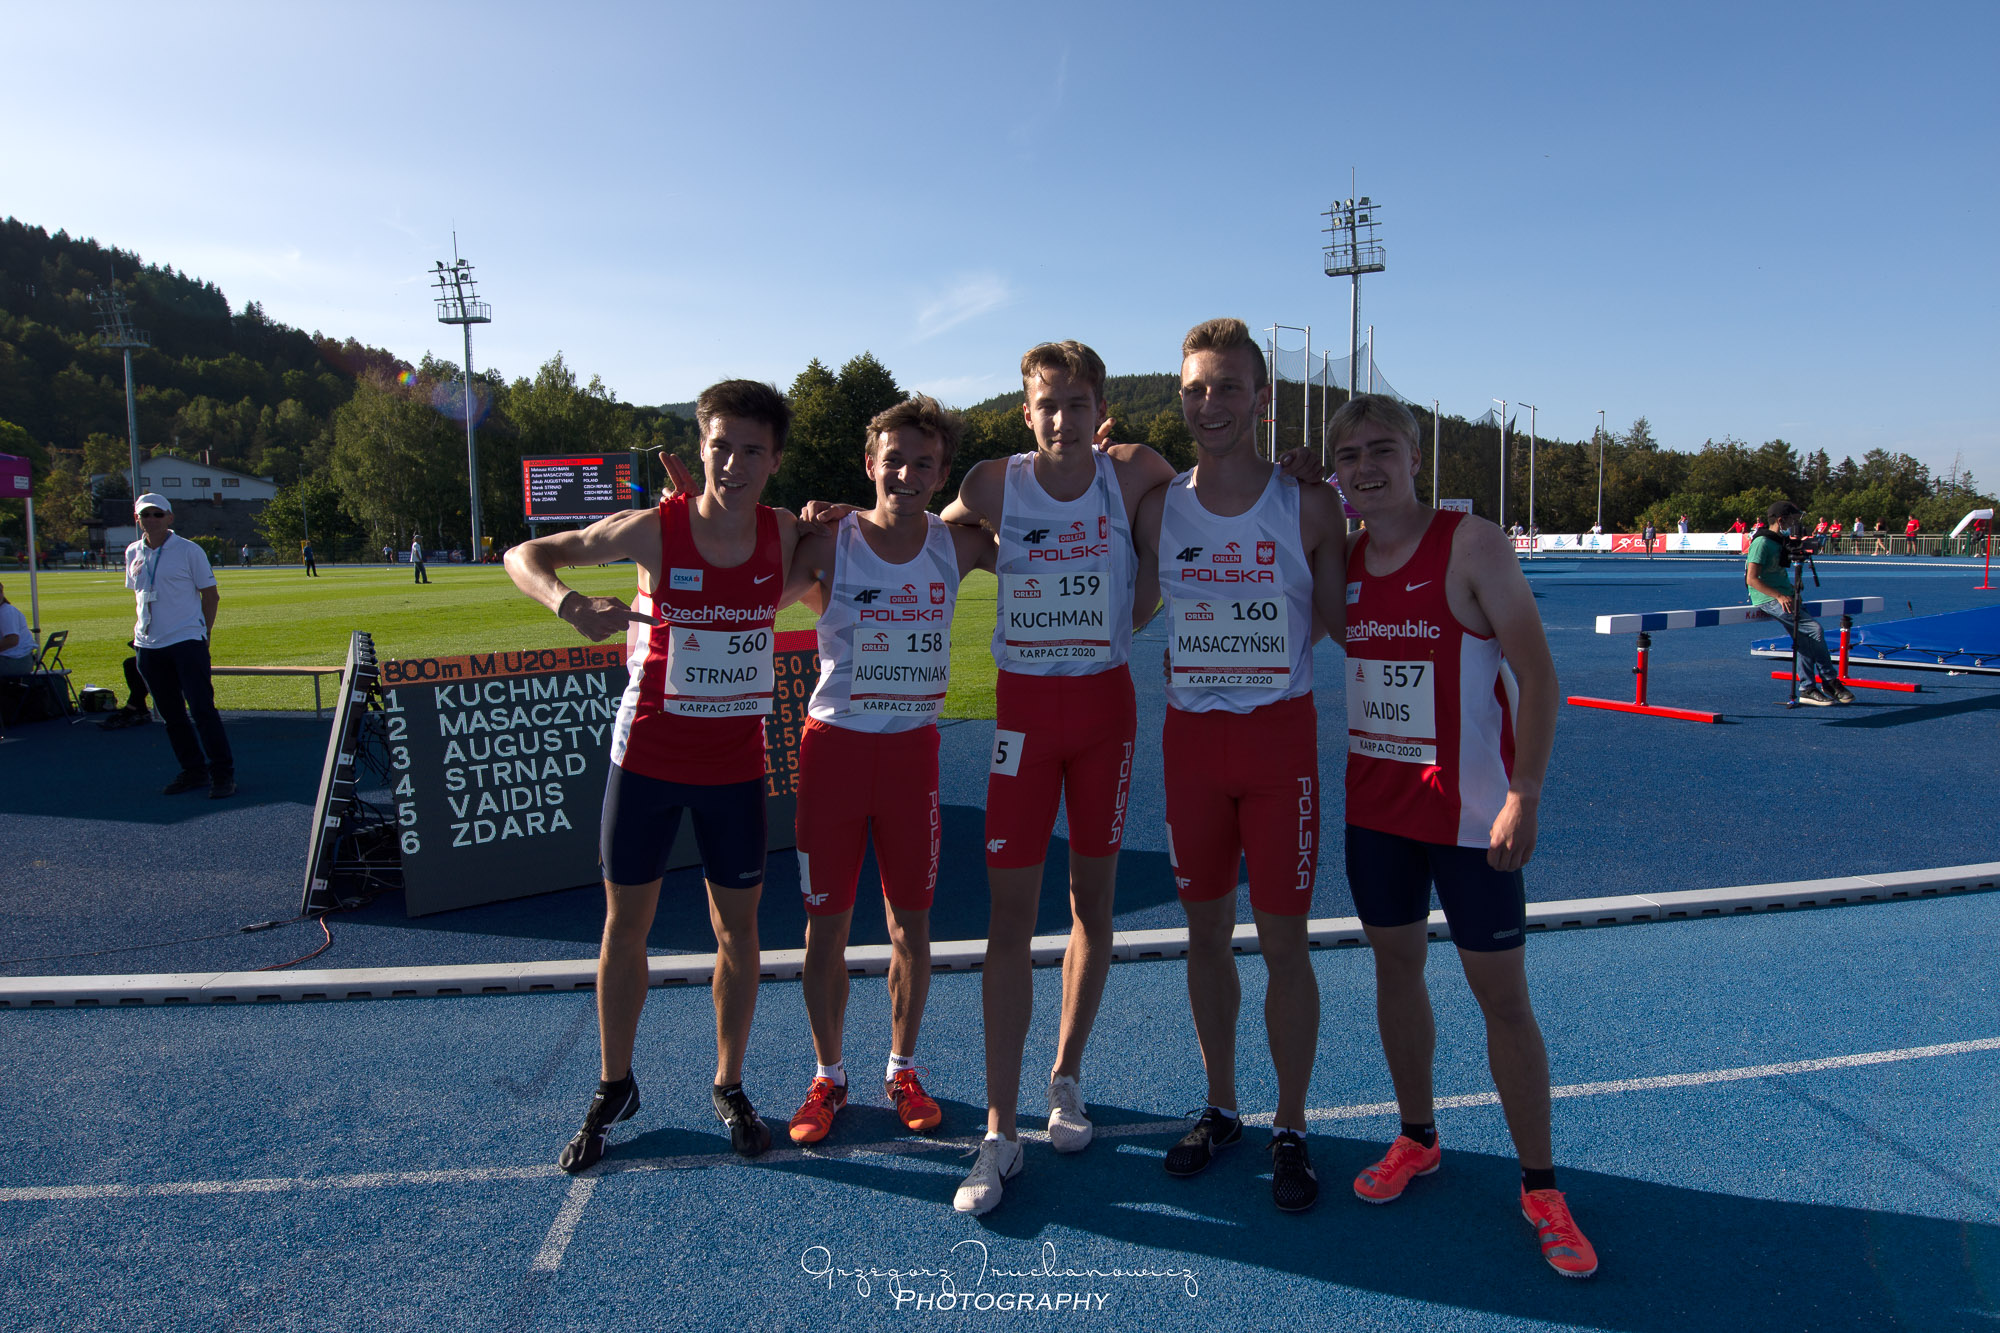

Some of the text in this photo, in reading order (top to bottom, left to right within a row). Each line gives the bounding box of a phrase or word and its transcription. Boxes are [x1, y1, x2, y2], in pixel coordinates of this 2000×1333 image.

[1023, 529, 1084, 544] 4F ORLEN
[1176, 547, 1203, 562] 4F
[1181, 568, 1274, 583] POLSKA
[1059, 576, 1100, 597] 159
[854, 590, 881, 603] 4F
[860, 609, 943, 621] POLSKA
[1010, 610, 1103, 628] KUCHMAN
[1231, 602, 1278, 621] 160
[728, 632, 767, 655] 560
[907, 633, 942, 652] 158
[1178, 632, 1285, 653] MASACZYŃSKI
[1020, 648, 1096, 658] KARPACZ 2020
[384, 658, 463, 683] 800m
[470, 653, 496, 677] M
[685, 666, 757, 684] STRNAD
[855, 665, 947, 682] AUGUSTYNIAK
[1383, 665, 1425, 688] 557
[1189, 676, 1272, 684] KARPACZ 2020
[386, 689, 405, 712] 1
[434, 672, 607, 710] KUCHMAN
[680, 701, 757, 712] KARPACZ 2020
[864, 701, 935, 712] KARPACZ 2020
[1363, 700, 1410, 722] VAIDIS
[388, 717, 408, 741] 2
[392, 746, 411, 770] 3
[443, 723, 614, 765] AUGUSTY
[996, 741, 1008, 764] 5
[1360, 739, 1422, 757] KARPACZ 2020
[396, 774, 415, 797] 4
[445, 753, 586, 791] STRNAD
[1108, 741, 1131, 844] POLSKA
[399, 802, 417, 826] 5
[448, 783, 564, 818] VAIDIS
[400, 830, 420, 855] 6
[451, 808, 572, 847] ZDARA
[926, 791, 939, 890] POLSKA
[1296, 776, 1312, 890] POLSKA
[987, 839, 1007, 853] 4F
[806, 893, 829, 905] 4F
